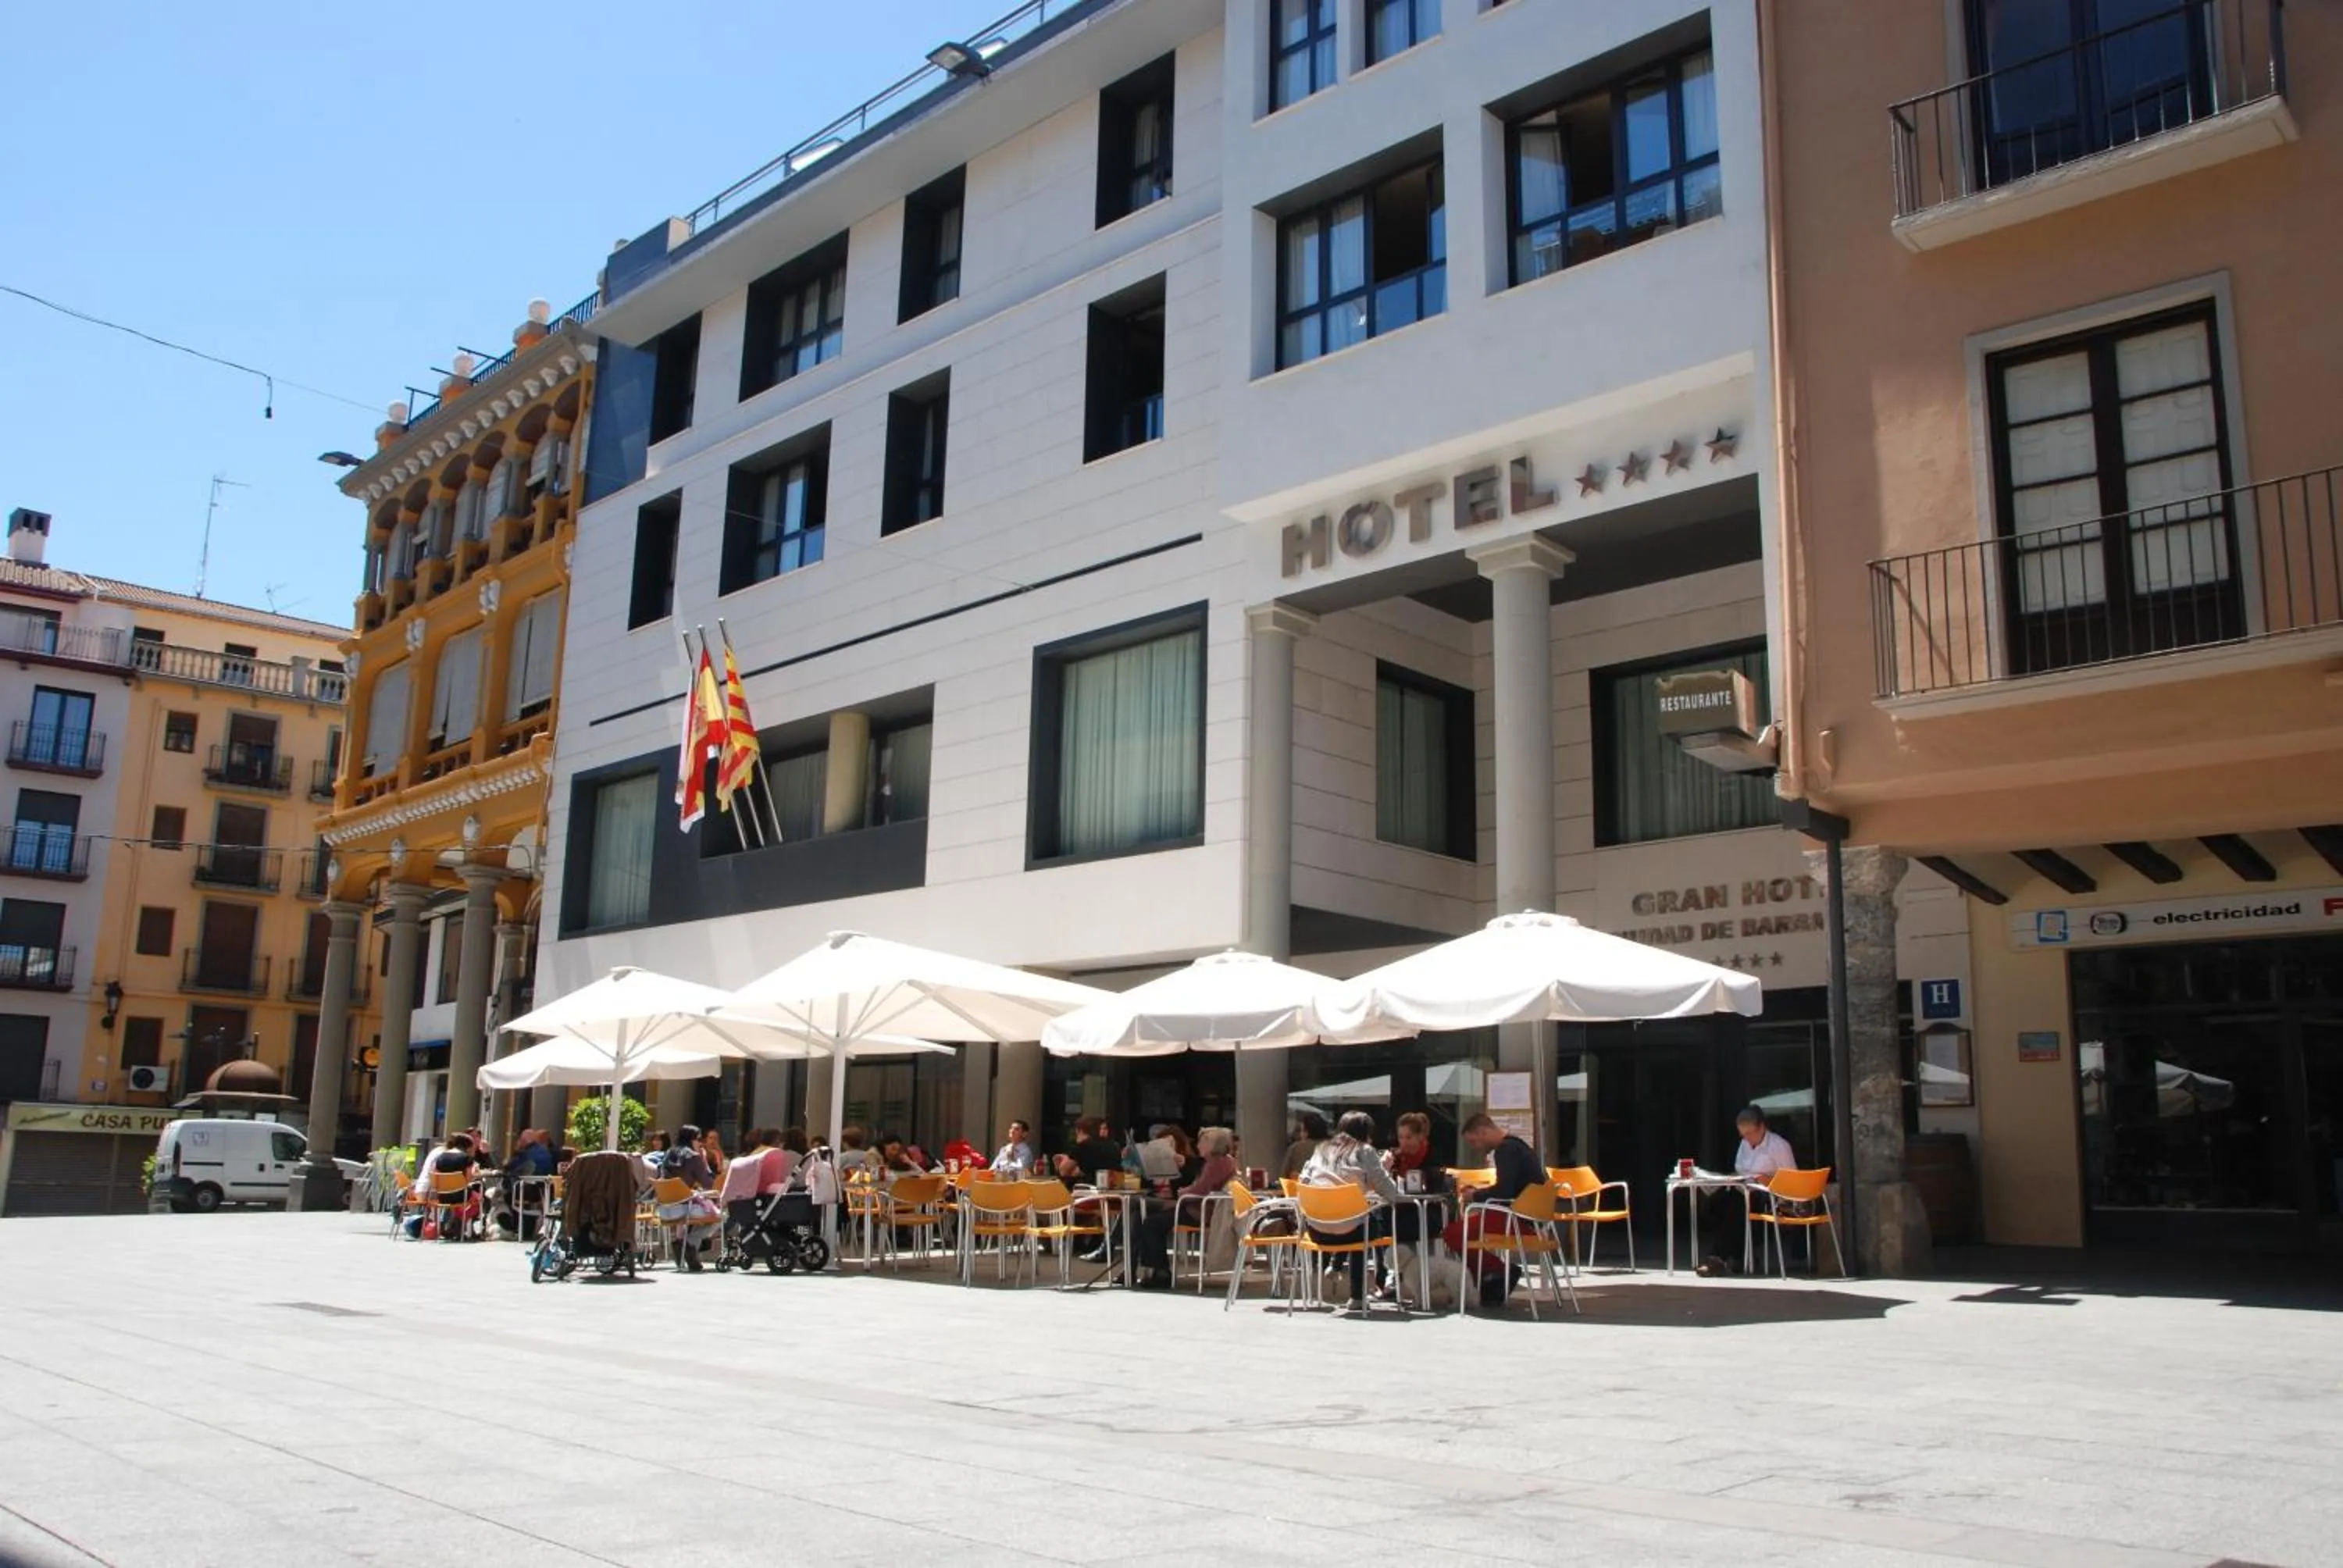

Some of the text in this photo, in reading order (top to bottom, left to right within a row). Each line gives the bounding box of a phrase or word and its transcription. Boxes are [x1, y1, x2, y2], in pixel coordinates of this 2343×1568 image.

[1281, 456, 1559, 578] HOTEL
[1660, 690, 1732, 712] RESTAURANTE
[1632, 875, 1824, 916] GRAN HOT
[2152, 903, 2302, 925] electricidad
[1701, 920, 1734, 941] DE
[1931, 983, 1950, 1004] H
[80, 1111, 132, 1129] CASA
